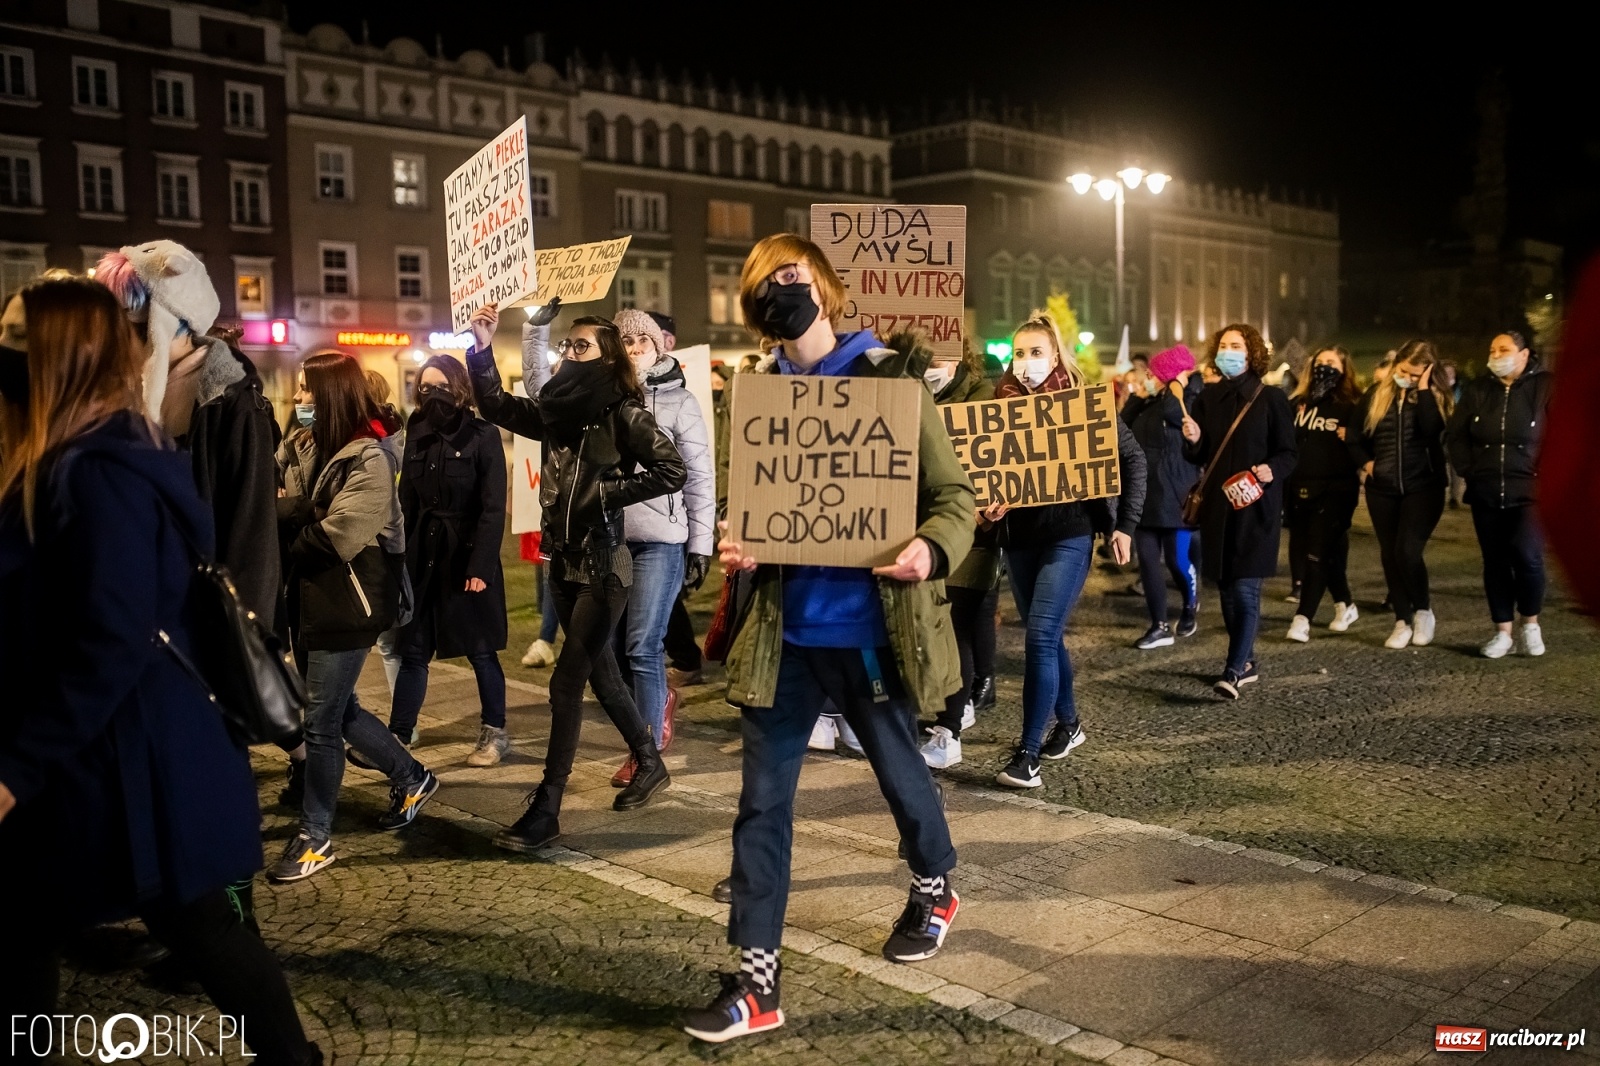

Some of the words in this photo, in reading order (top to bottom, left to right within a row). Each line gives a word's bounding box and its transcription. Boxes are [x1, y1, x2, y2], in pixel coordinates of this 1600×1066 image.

[446, 153, 485, 208] WITAMY
[486, 147, 494, 177] W
[496, 128, 524, 170] PIEKLE
[448, 207, 461, 236] TU
[503, 157, 525, 194] JEST
[830, 208, 932, 245] DUDA
[451, 232, 470, 263] JAK
[565, 248, 583, 264] TO
[588, 241, 627, 261] TWOJA
[851, 234, 953, 266] MYŚLI
[487, 261, 498, 280] CO
[547, 265, 586, 282] TWOJA
[861, 269, 887, 295] IN
[894, 270, 964, 298] VITRO
[556, 281, 585, 298] WINA
[454, 300, 480, 330] MEDIA
[337, 331, 412, 346] RESTAURACJA
[790, 379, 851, 411] PIS
[743, 416, 896, 449] CHOWA
[754, 449, 913, 486] NUTELLE
[796, 483, 845, 508] DO
[741, 506, 887, 544] LODÓWKI
